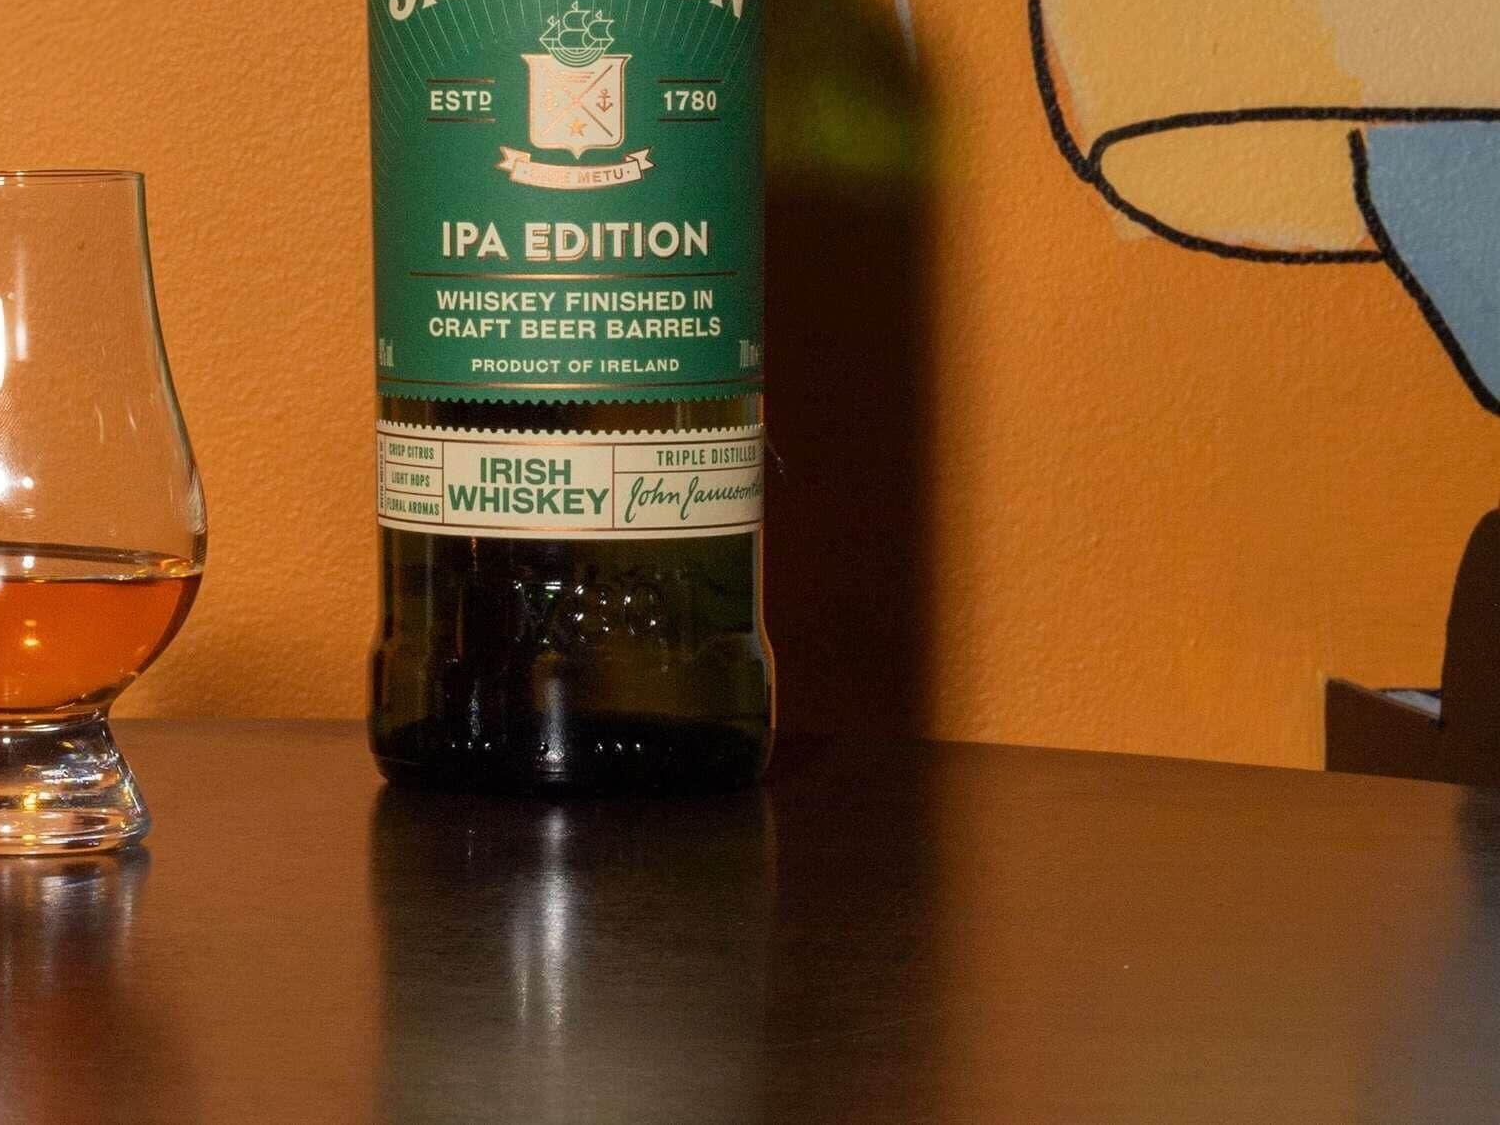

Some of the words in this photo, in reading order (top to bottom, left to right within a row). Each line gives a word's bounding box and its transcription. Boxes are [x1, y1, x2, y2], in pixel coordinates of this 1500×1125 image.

[430, 89, 492, 112] ESTD
[663, 90, 717, 111] 1780
[577, 167, 624, 183] METU
[442, 221, 509, 259] IPA
[524, 221, 709, 262] EDITION
[436, 290, 557, 312] WHISKEY
[565, 290, 686, 312] FINISHED
[693, 289, 713, 310] IN
[429, 316, 512, 339] CRAFT
[520, 318, 596, 340] BEER
[606, 316, 721, 340] BARRELS
[471, 358, 561, 374] PRODUCT
[567, 359, 593, 374] OF
[600, 358, 680, 373] IRELAND
[407, 445, 434, 460] CITRUS
[656, 449, 706, 466] TRIPLE
[391, 471, 409, 485] LIGHT
[410, 474, 430, 488] HOPS
[480, 457, 571, 486] IRISH
[408, 501, 440, 516] AROMAS
[448, 484, 609, 515] WHISKEY
[624, 476, 680, 524] John
